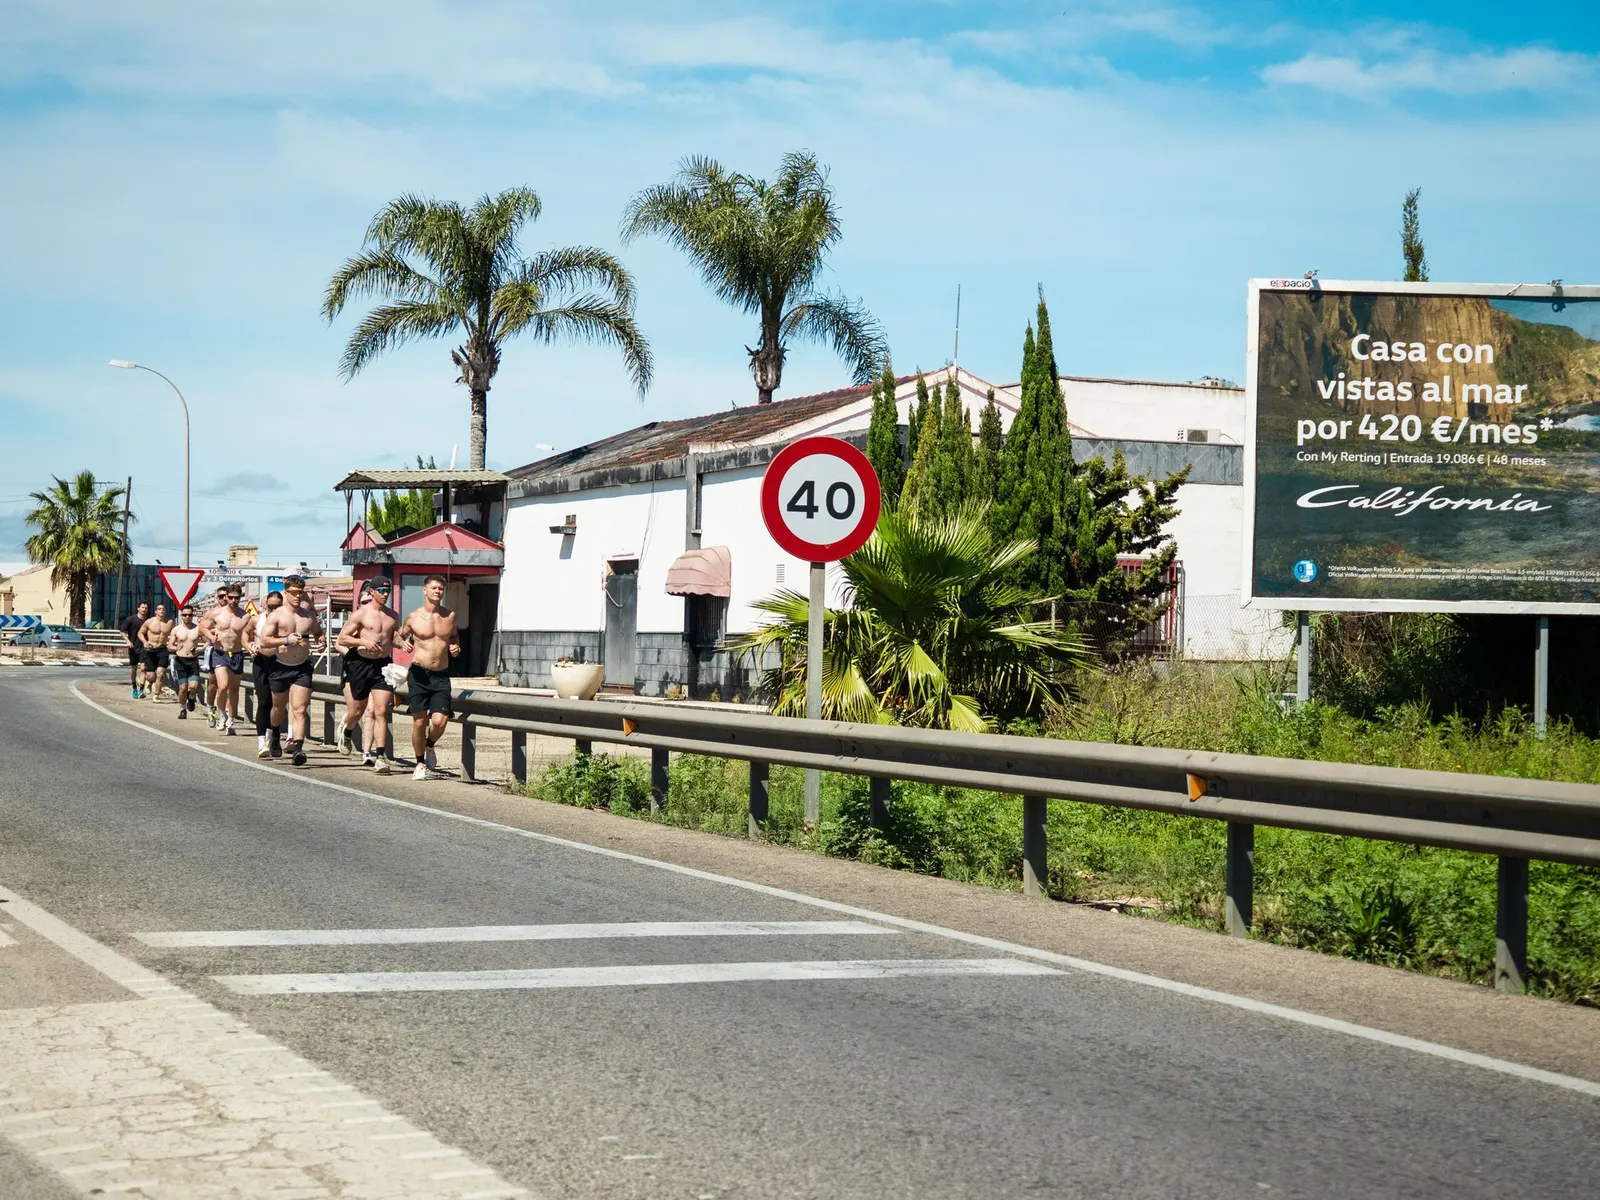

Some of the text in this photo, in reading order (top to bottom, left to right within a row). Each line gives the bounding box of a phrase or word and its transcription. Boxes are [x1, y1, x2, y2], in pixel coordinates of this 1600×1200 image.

[1270, 279, 1311, 289] espacio
[1351, 333, 1494, 364] Casa con
[1316, 372, 1528, 404] vistas al mar
[1297, 419, 1353, 446] por
[1358, 414, 1422, 442] 420
[1296, 451, 1319, 462] Con
[1321, 451, 1338, 464] My
[1390, 453, 1433, 464] Entrada
[1493, 454, 1508, 465] 48
[1510, 456, 1547, 466] meses
[786, 480, 856, 520] 40
[1296, 484, 1552, 517] California
